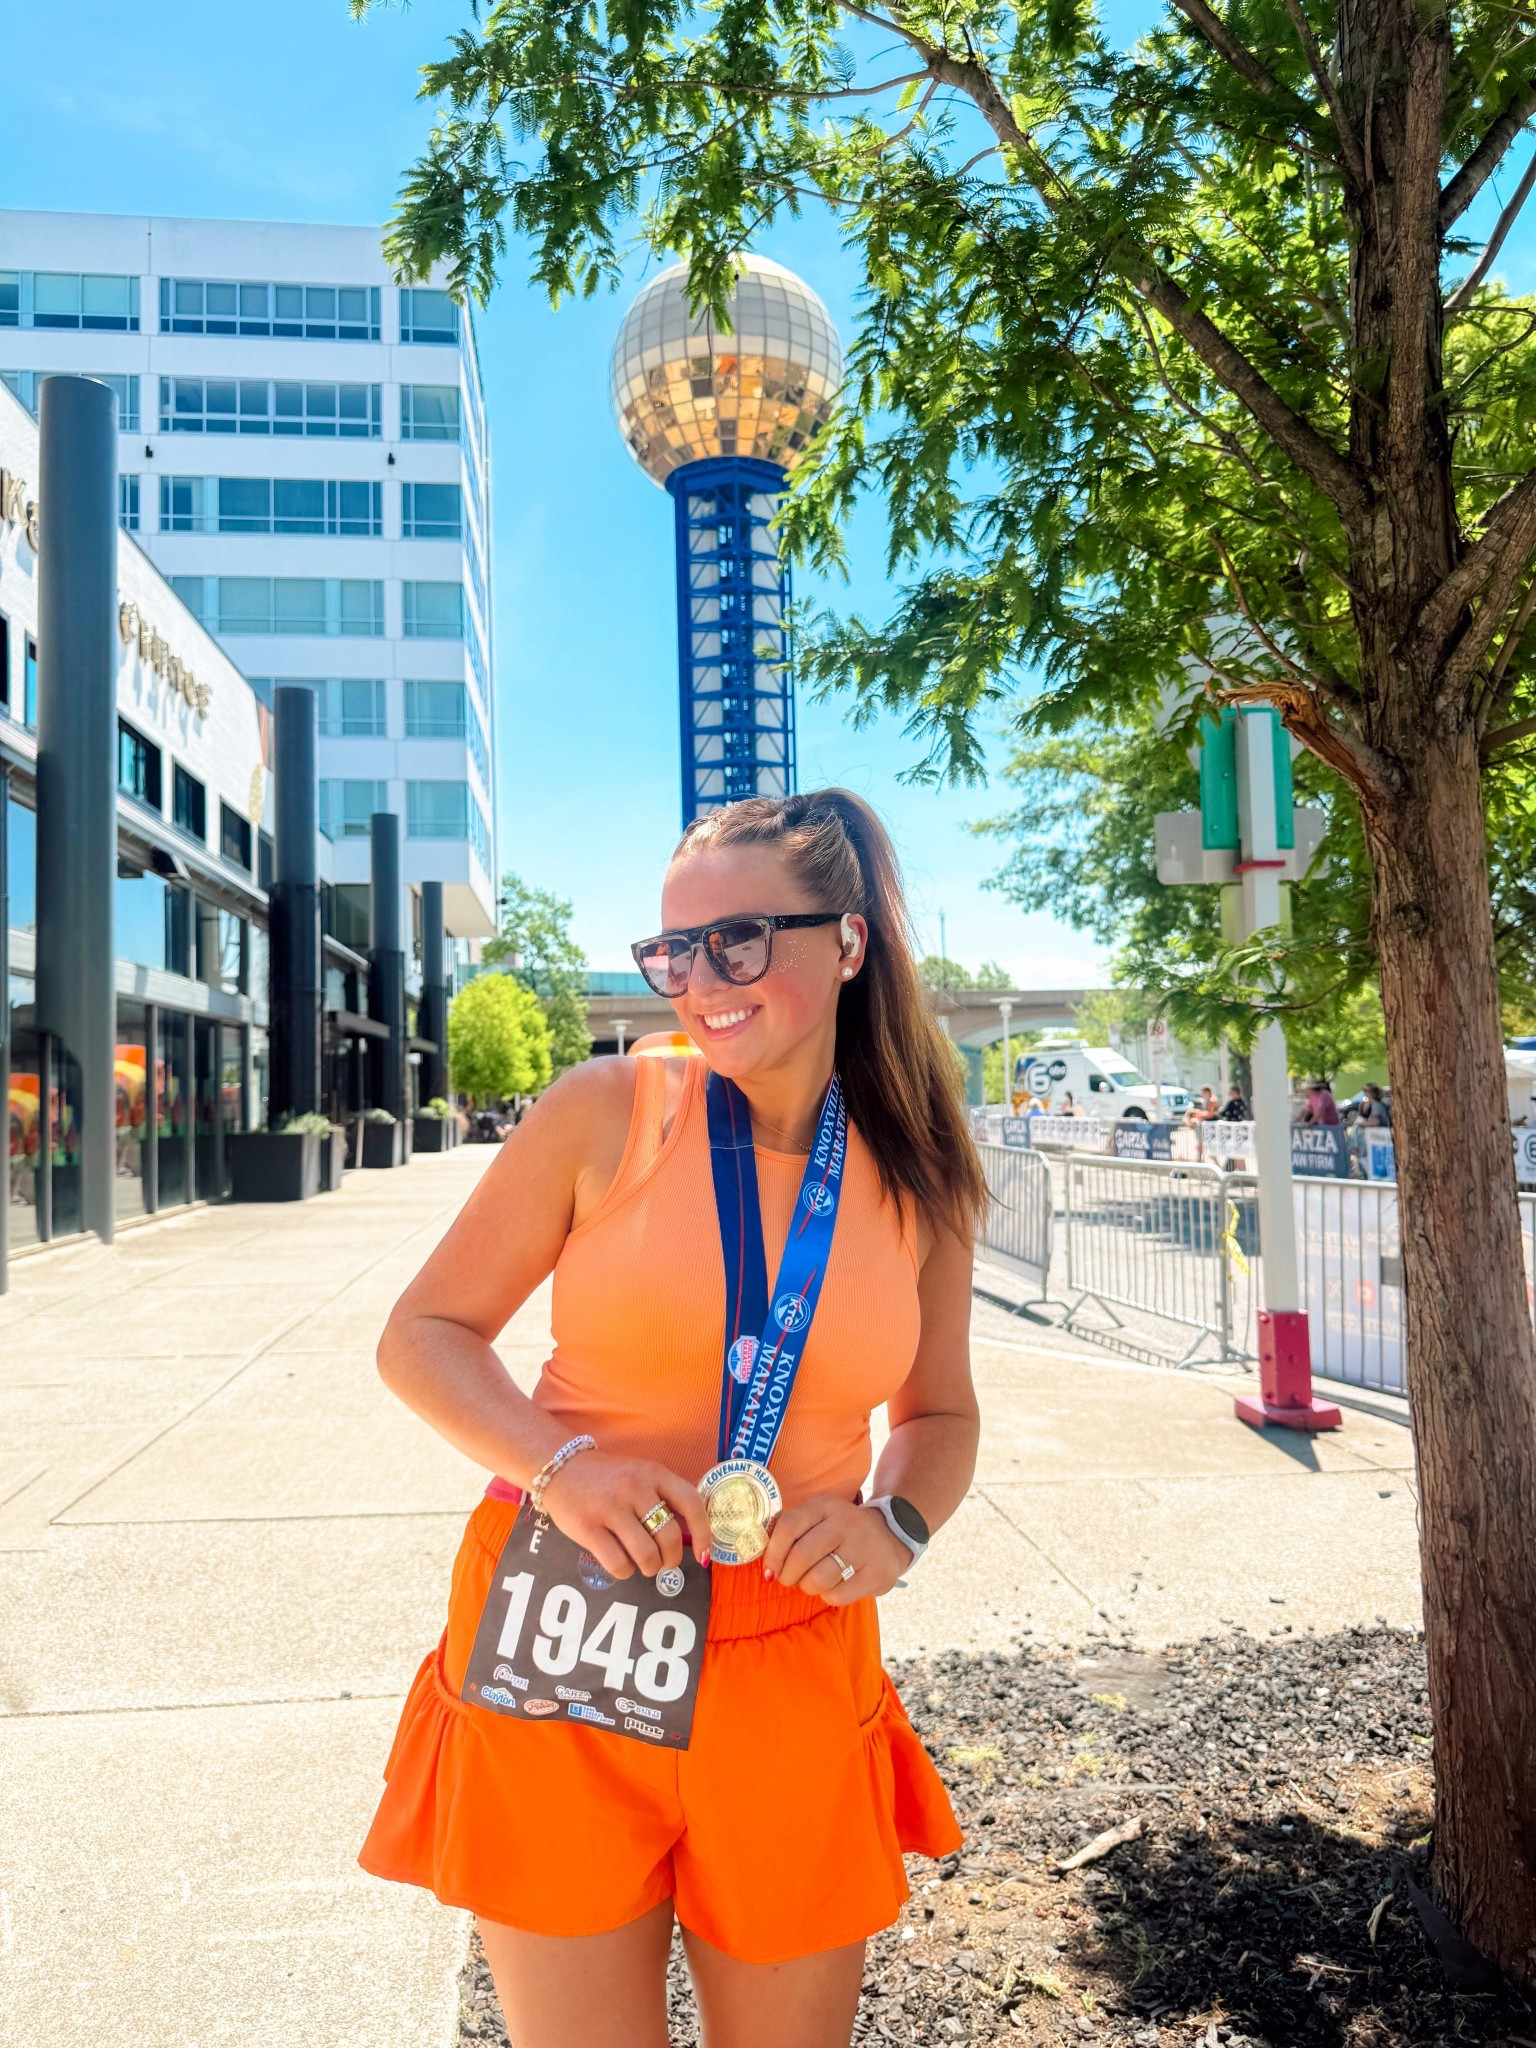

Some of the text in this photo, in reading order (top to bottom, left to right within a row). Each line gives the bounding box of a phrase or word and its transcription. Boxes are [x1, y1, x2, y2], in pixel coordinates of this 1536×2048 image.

[1029, 1065, 1050, 1093] 6
[827, 1092, 848, 1180] MARATHO
[1292, 1129, 1339, 1154] ARZA
[1292, 1154, 1335, 1170] AW FIRM
[731, 1342, 779, 1460] MARATHO
[706, 1462, 778, 1500] COVENANT HEALTH
[661, 1577, 679, 1587] KTC
[496, 1571, 697, 1702] 1948
[481, 1686, 515, 1707] Clayton
[556, 1686, 591, 1698] GARZA
[626, 1718, 664, 1736] pilot
